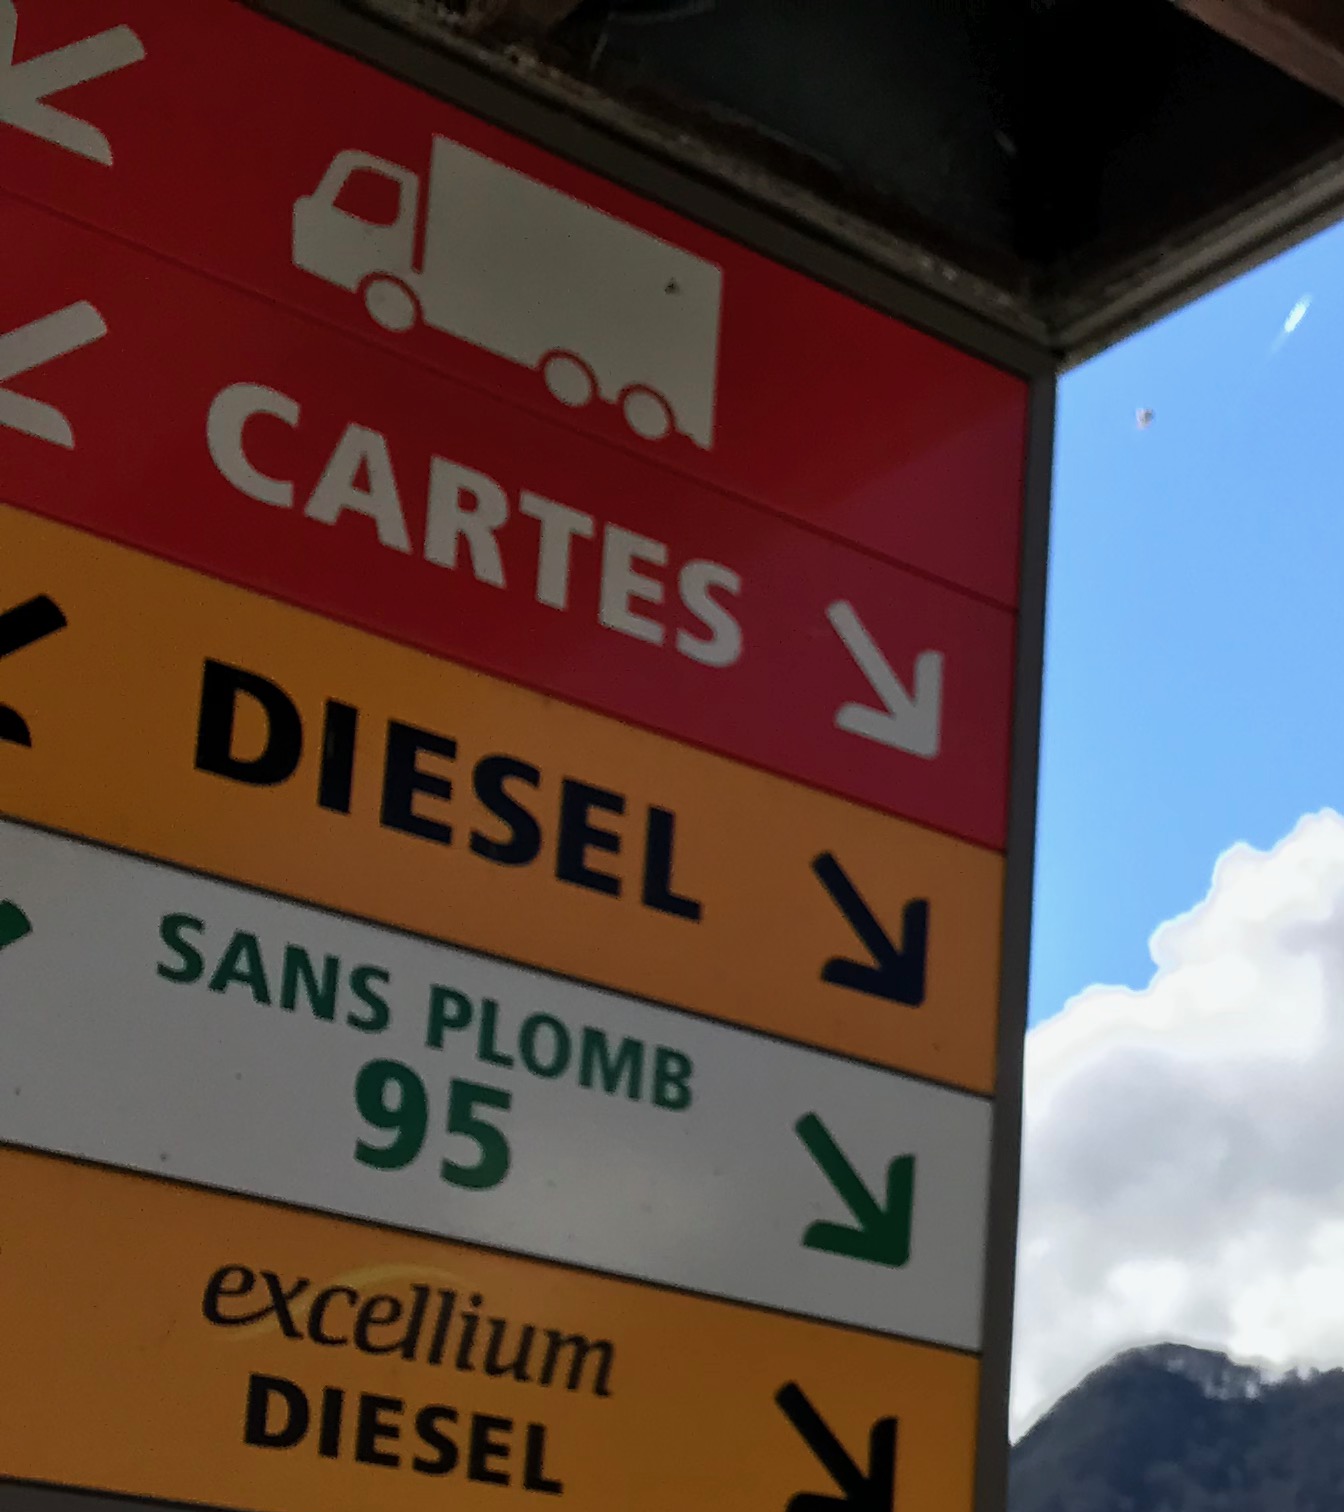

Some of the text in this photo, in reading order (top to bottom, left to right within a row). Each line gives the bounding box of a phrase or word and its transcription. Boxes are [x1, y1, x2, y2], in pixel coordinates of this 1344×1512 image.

[207, 382, 744, 668] CARTES
[194, 657, 703, 924] DIESEL
[157, 913, 693, 1111] SANS PLOMB
[355, 1059, 514, 1189] 95
[202, 1264, 614, 1398] excellium
[244, 1373, 563, 1495] DIESEL
